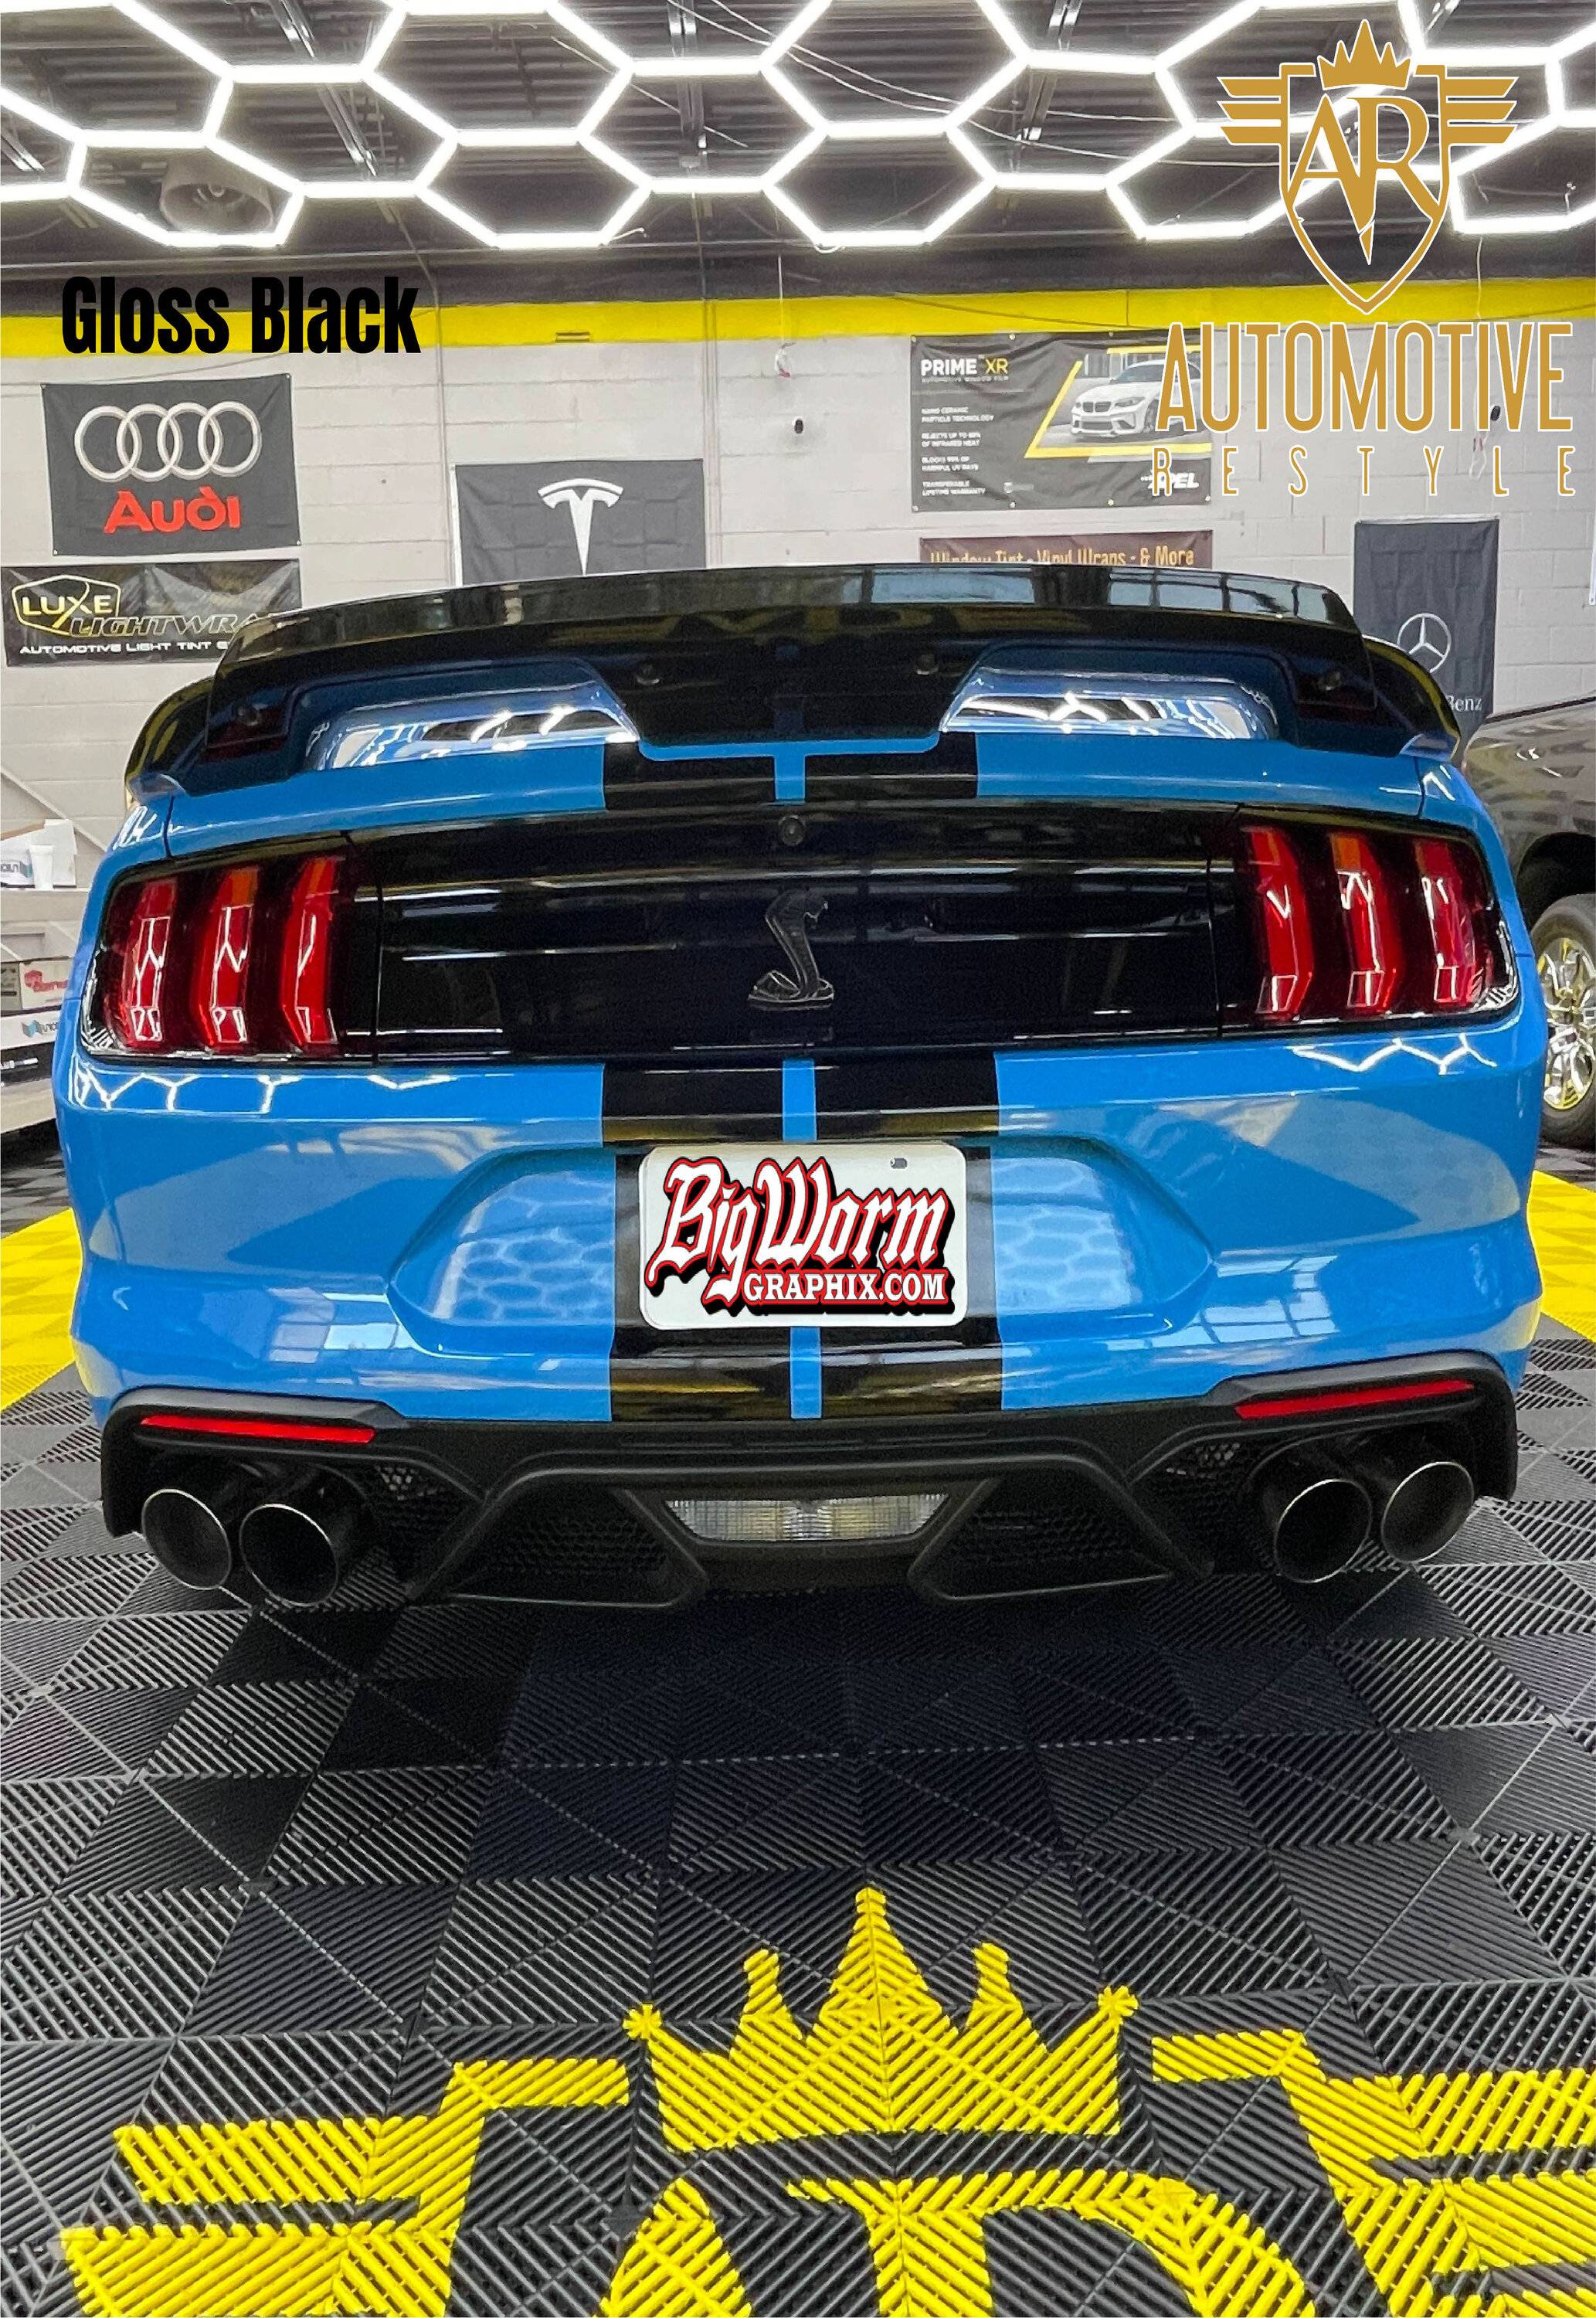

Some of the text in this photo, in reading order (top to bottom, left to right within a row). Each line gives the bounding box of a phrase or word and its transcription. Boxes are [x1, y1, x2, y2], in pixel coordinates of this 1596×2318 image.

[921, 358, 1008, 376] PRIME XR
[104, 487, 241, 534] Audi
[1140, 547, 1150, 566] &
[1156, 545, 1194, 566] More
[22, 596, 114, 628] LUXE
[20, 643, 121, 654] AUTOMOTIVE
[126, 642, 171, 652] LIGHT
[177, 641, 212, 651] TINT
